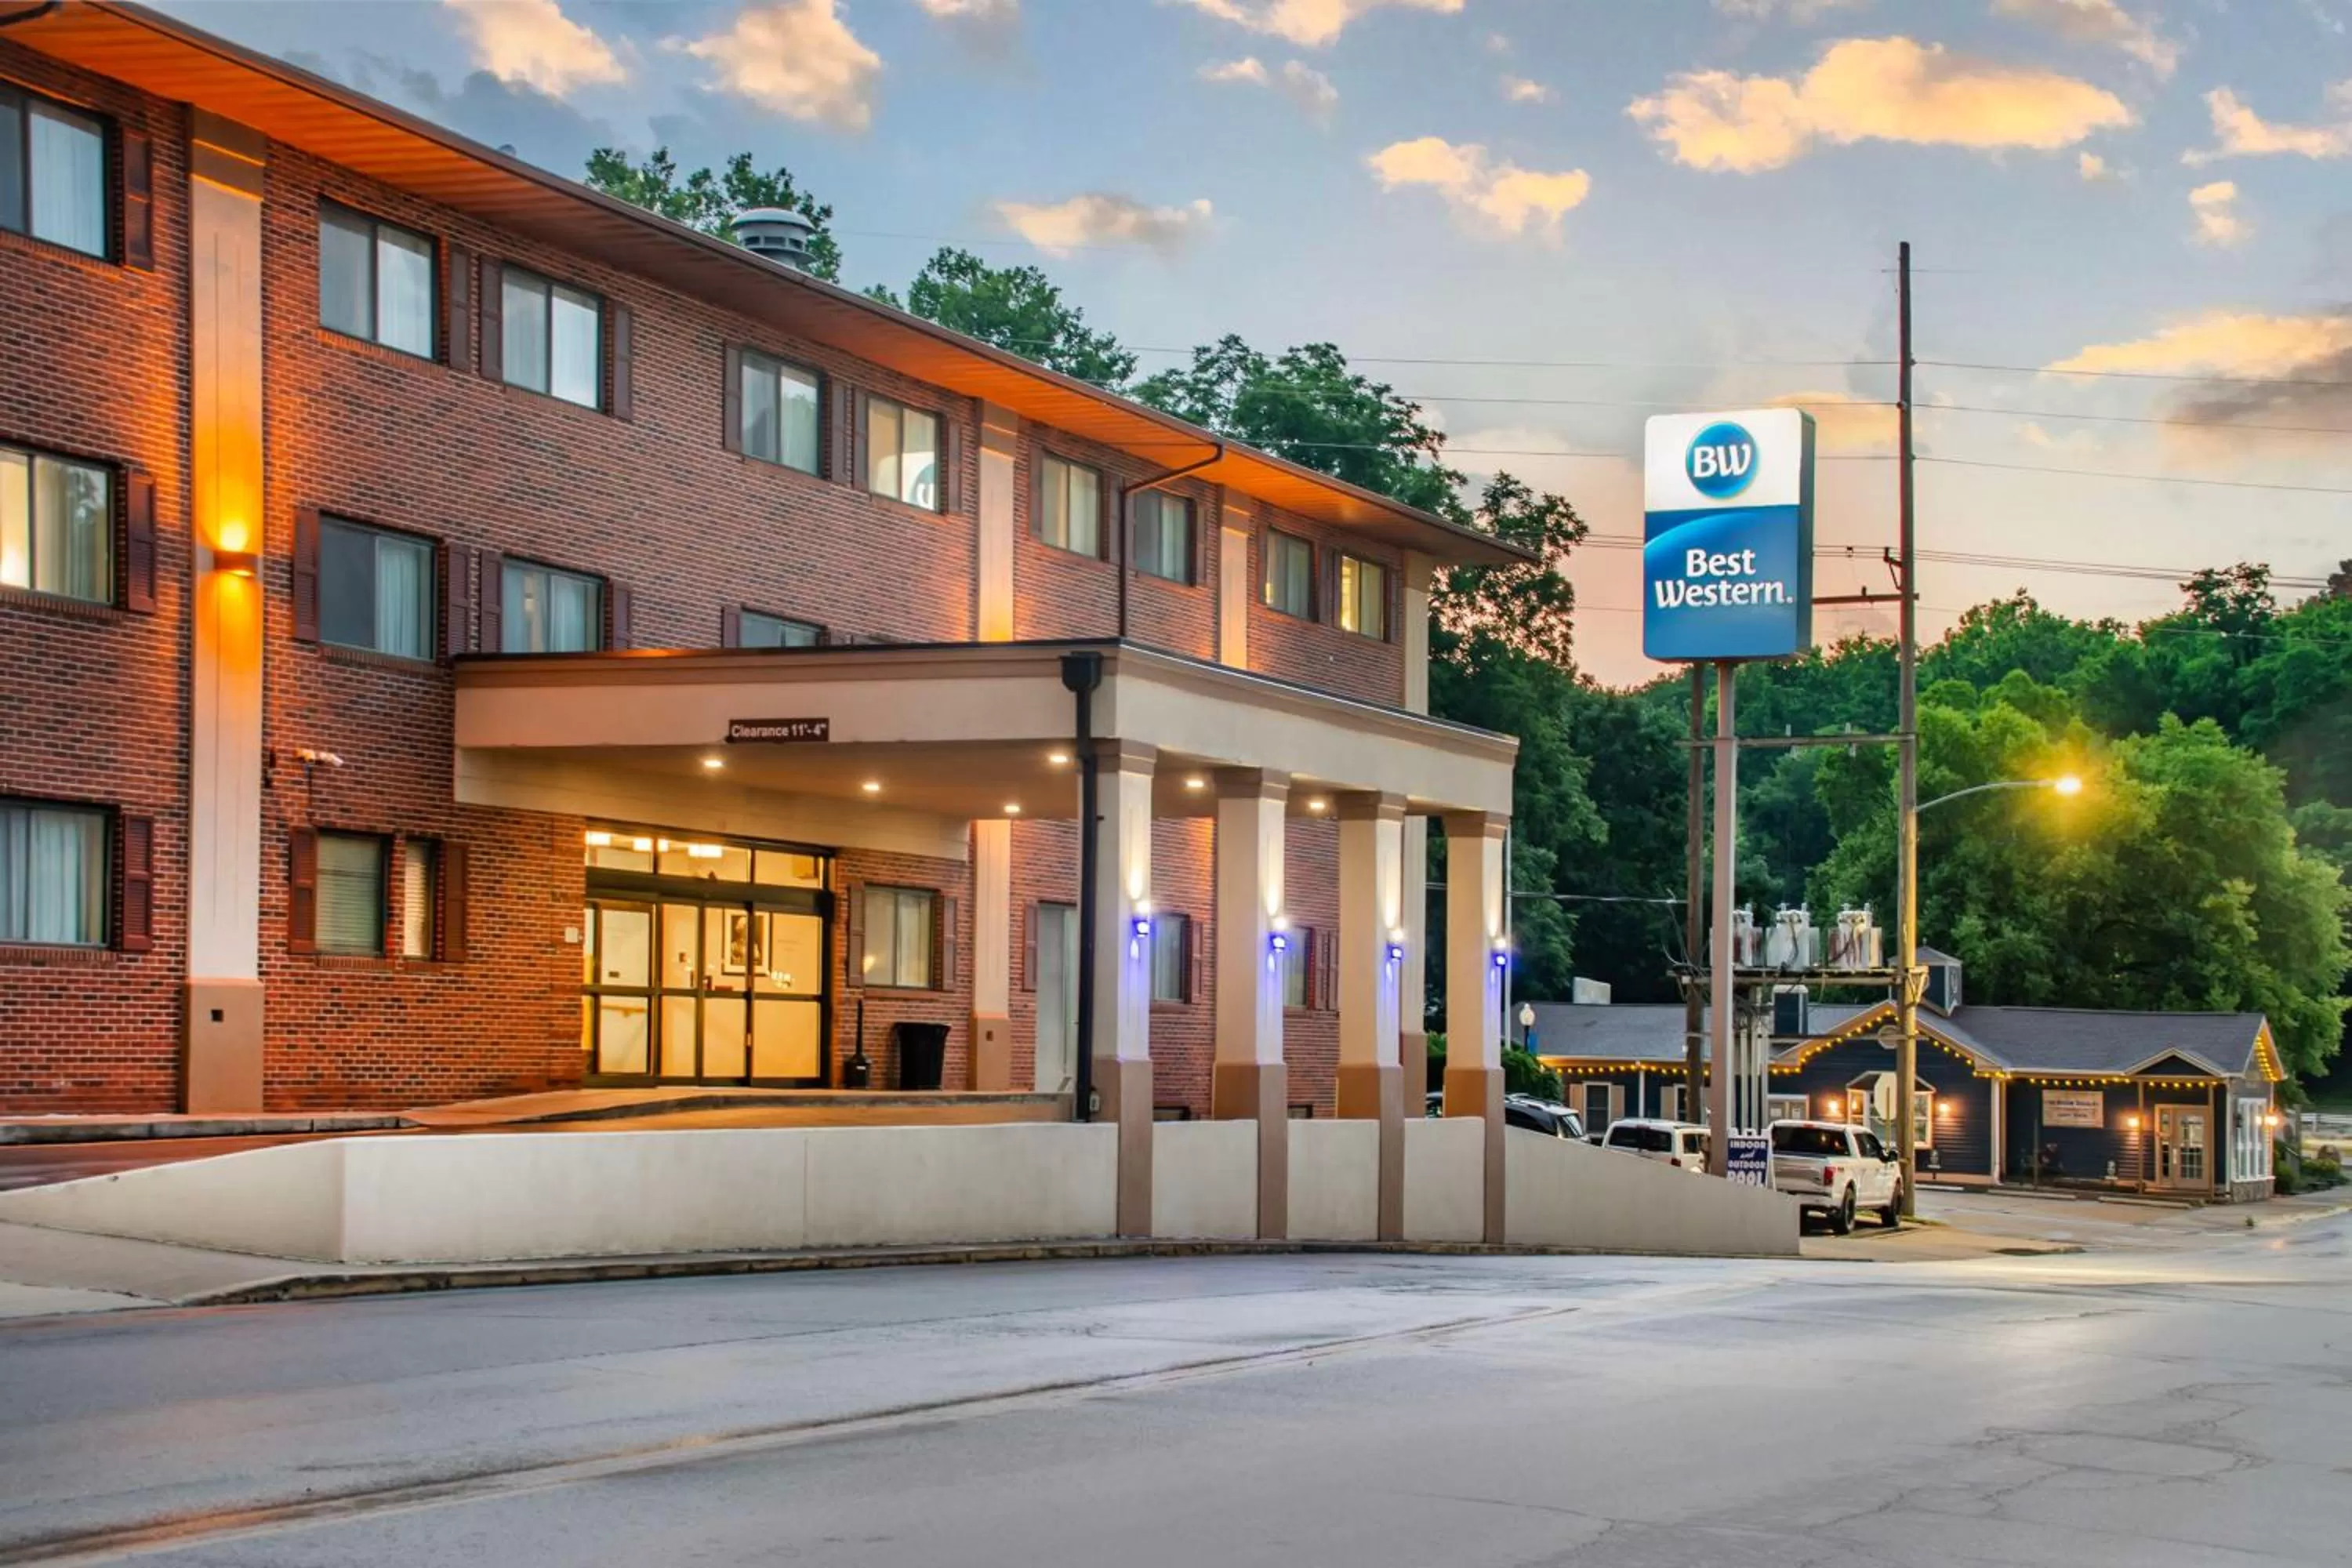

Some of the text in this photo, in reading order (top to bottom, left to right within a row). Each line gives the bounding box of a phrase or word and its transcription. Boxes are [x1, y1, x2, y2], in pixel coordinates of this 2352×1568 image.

[1693, 443, 1751, 477] BW
[1686, 548, 1757, 578] Best
[731, 724, 789, 737] Clearance
[1727, 1160, 1766, 1169] OUTDOOR
[1727, 1171, 1766, 1189] POOL
